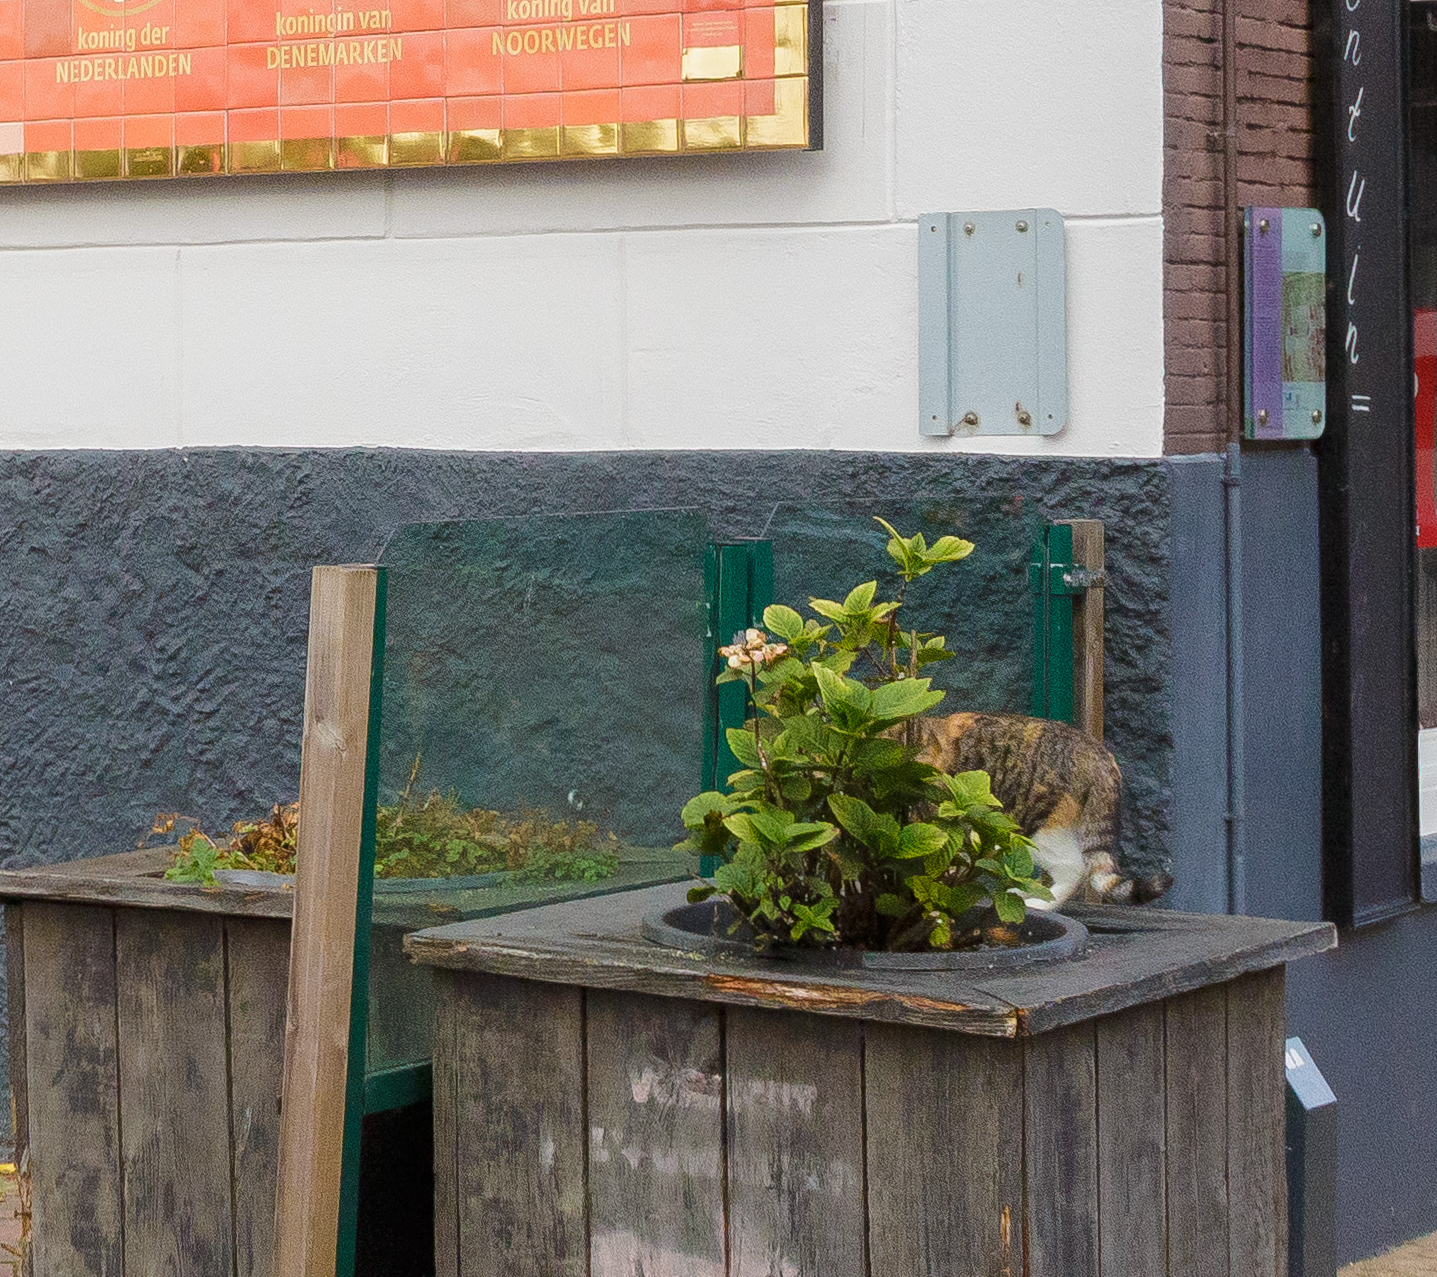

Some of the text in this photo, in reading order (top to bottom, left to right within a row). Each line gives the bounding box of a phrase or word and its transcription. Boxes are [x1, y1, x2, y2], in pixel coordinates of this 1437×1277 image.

[77, 21, 170, 53] koning der
[275, 7, 392, 39] koningin van
[491, 20, 632, 56] NOORWEGEN
[55, 52, 191, 84] NEDERLANDEN
[266, 37, 402, 71] DENEMARKEN
